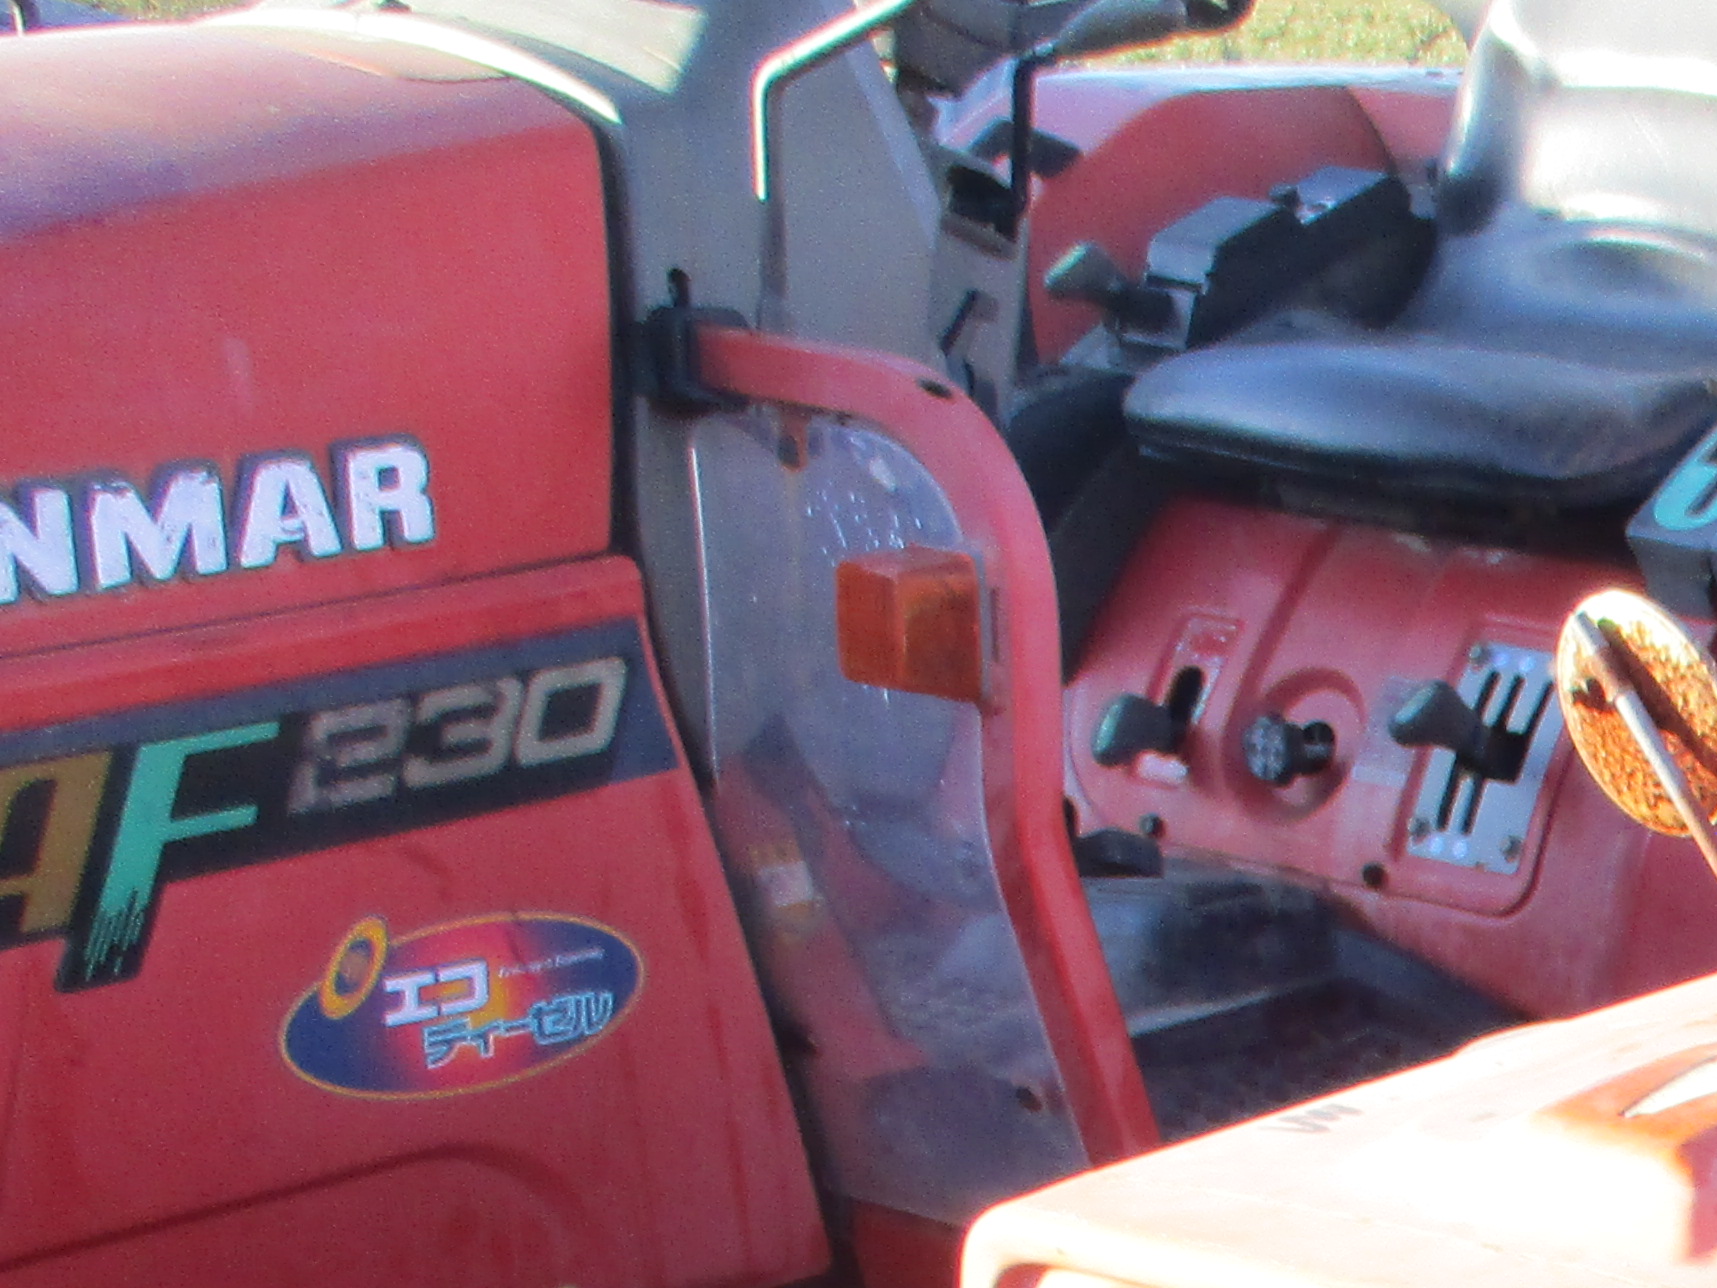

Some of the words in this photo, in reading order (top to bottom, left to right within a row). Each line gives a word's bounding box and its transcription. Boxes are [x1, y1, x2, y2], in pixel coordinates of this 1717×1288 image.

[0, 443, 436, 604] NMAR
[384, 957, 490, 1027] エコ
[422, 988, 614, 1070] ディーゼル
